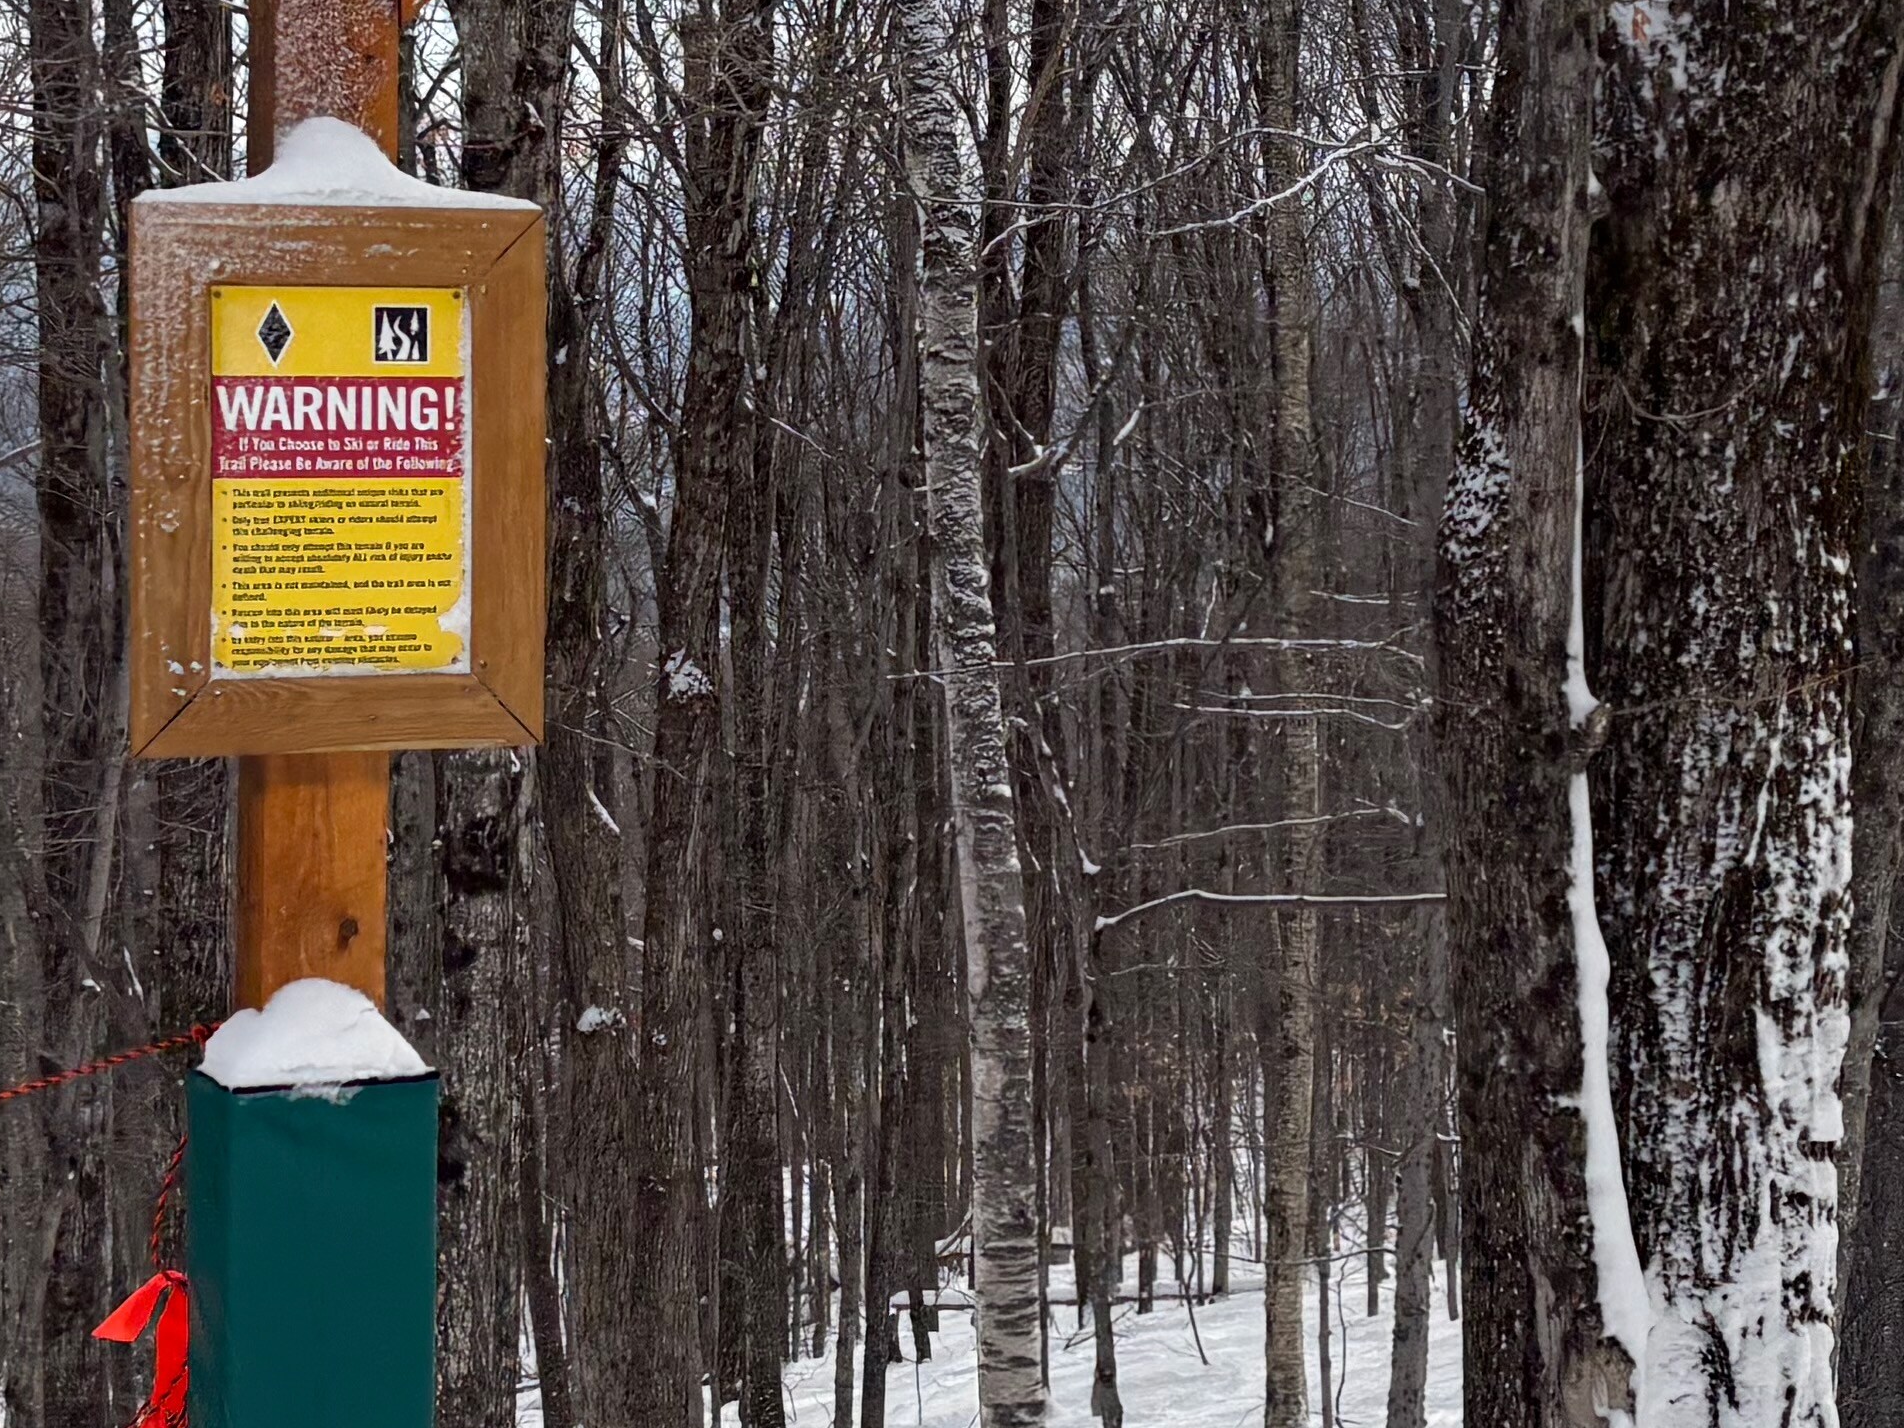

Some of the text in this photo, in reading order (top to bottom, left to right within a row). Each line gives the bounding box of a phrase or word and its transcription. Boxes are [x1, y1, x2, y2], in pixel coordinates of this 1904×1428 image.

[216, 385, 456, 432] WARNING!
[252, 436, 275, 451] You
[279, 436, 324, 451] Choose
[328, 436, 340, 451] to
[344, 436, 363, 451] Ski
[367, 436, 379, 451] or
[383, 436, 410, 451] Ride
[414, 436, 439, 451] This
[219, 456, 247, 473] Trail
[249, 456, 292, 471] Please
[296, 456, 312, 471] Be
[315, 456, 353, 471] Aware
[357, 456, 369, 471] of
[372, 456, 393, 471] the
